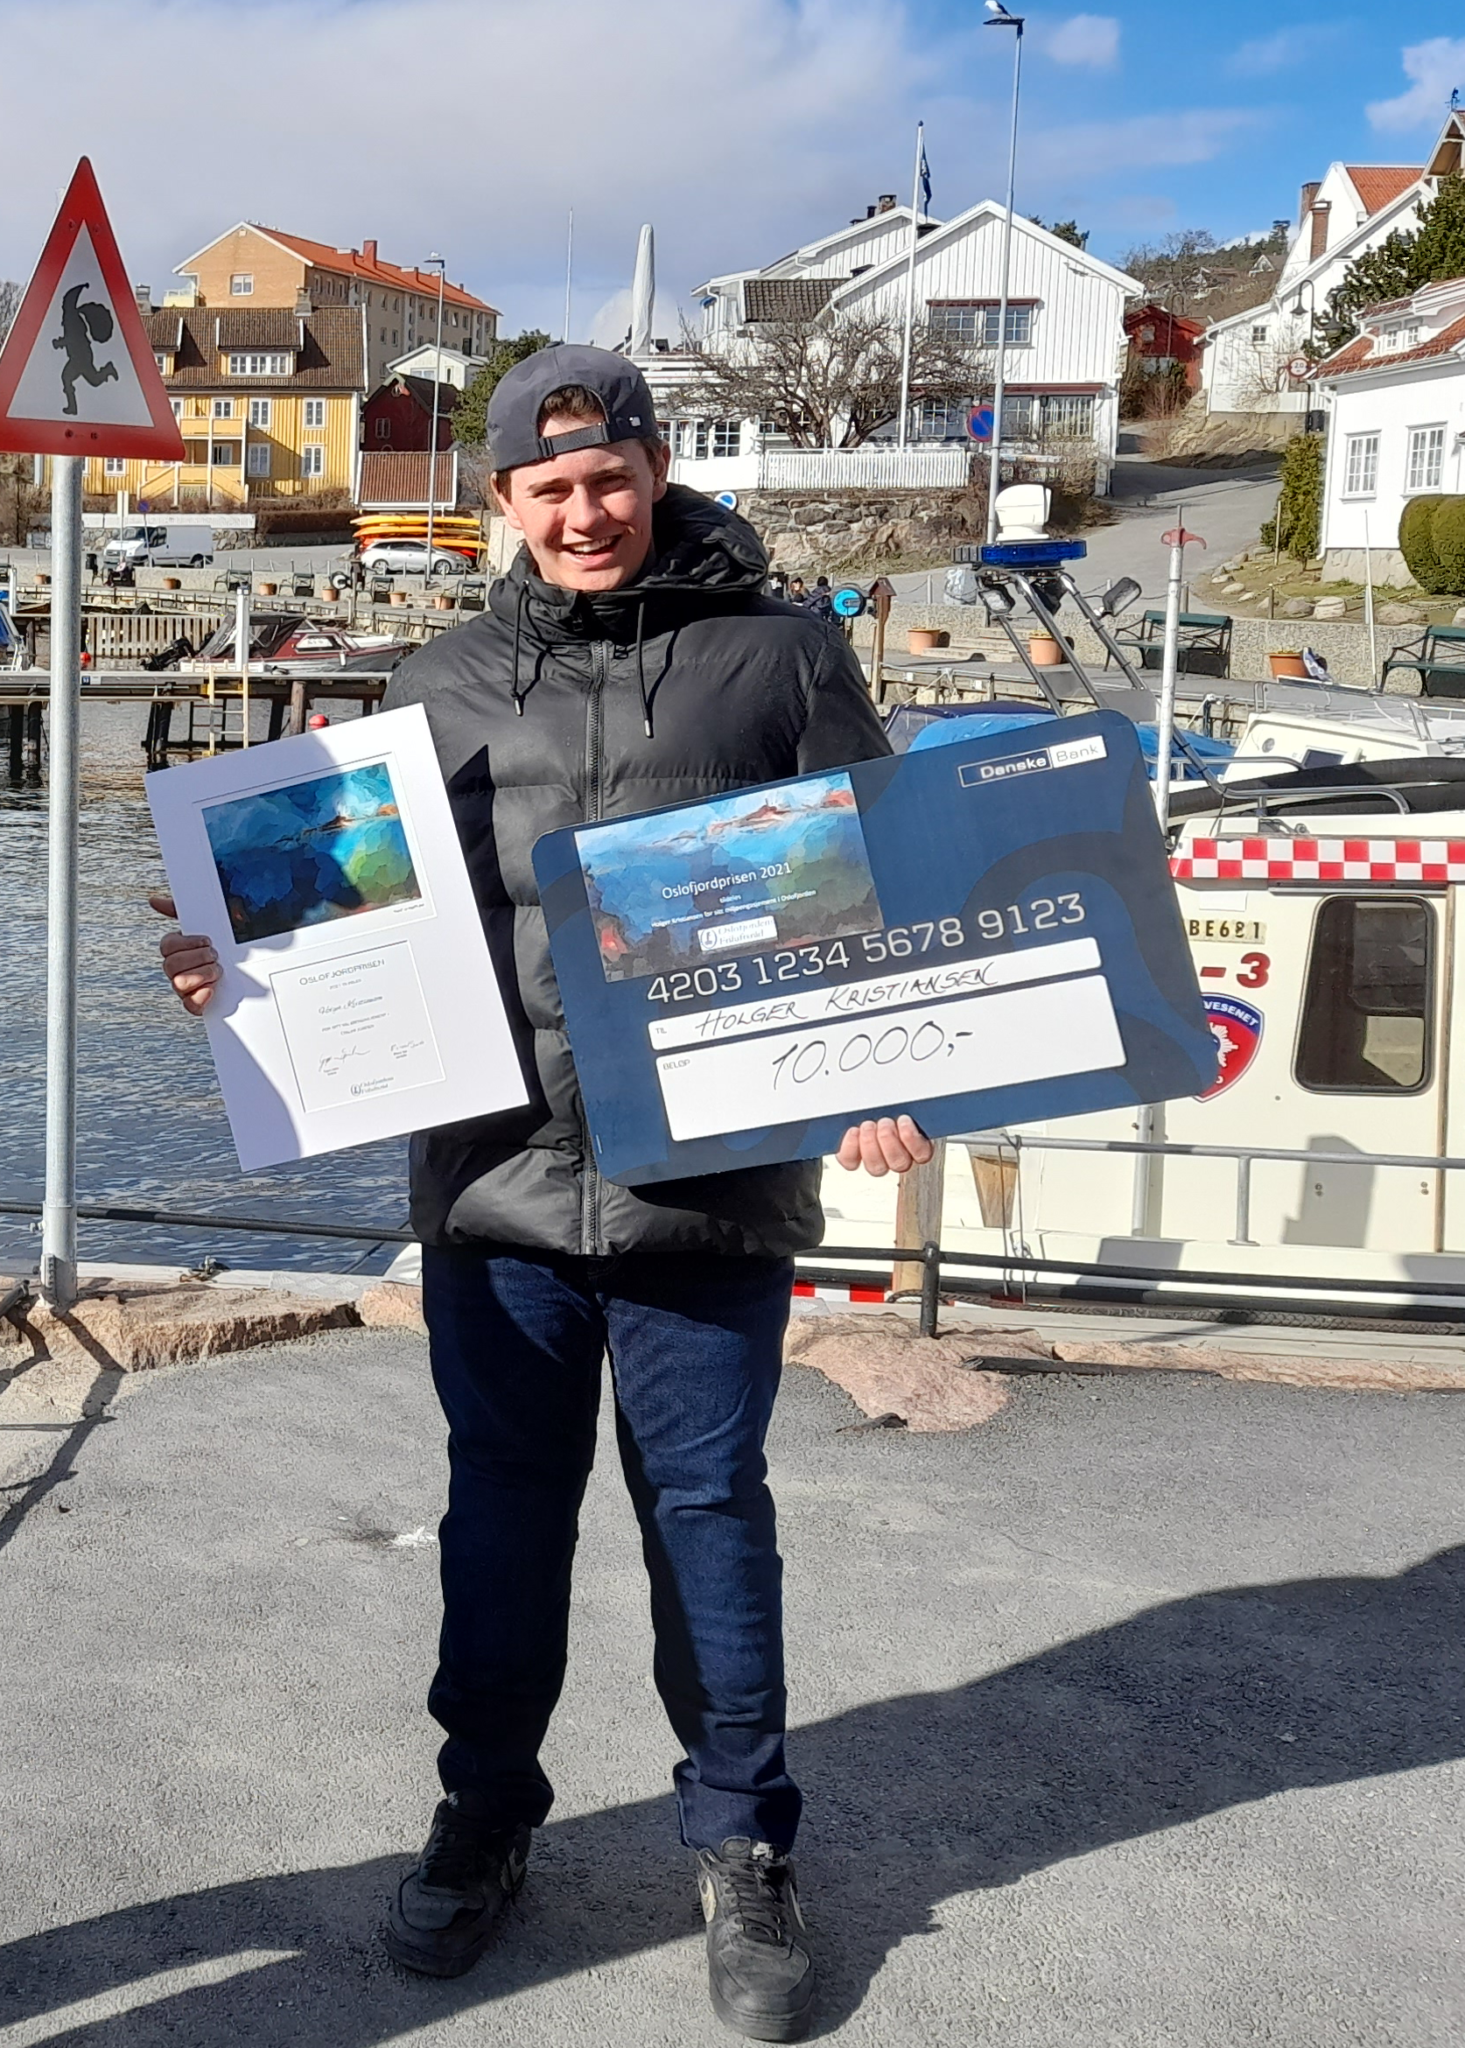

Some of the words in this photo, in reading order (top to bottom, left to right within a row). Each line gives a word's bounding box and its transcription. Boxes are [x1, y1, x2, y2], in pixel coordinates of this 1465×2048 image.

[980, 757, 1047, 779] Danske
[1056, 744, 1099, 763] Bank
[662, 870, 757, 899] Oslofjordprisen
[760, 862, 792, 879] 2021
[647, 962, 742, 1003] 4203
[752, 941, 850, 985] 1234
[862, 918, 965, 963] 5678
[978, 892, 1085, 939] 9123
[695, 1002, 808, 1037] HOLGER
[825, 962, 998, 1011] KRISTIANSEN
[655, 1027, 667, 1035] TIL
